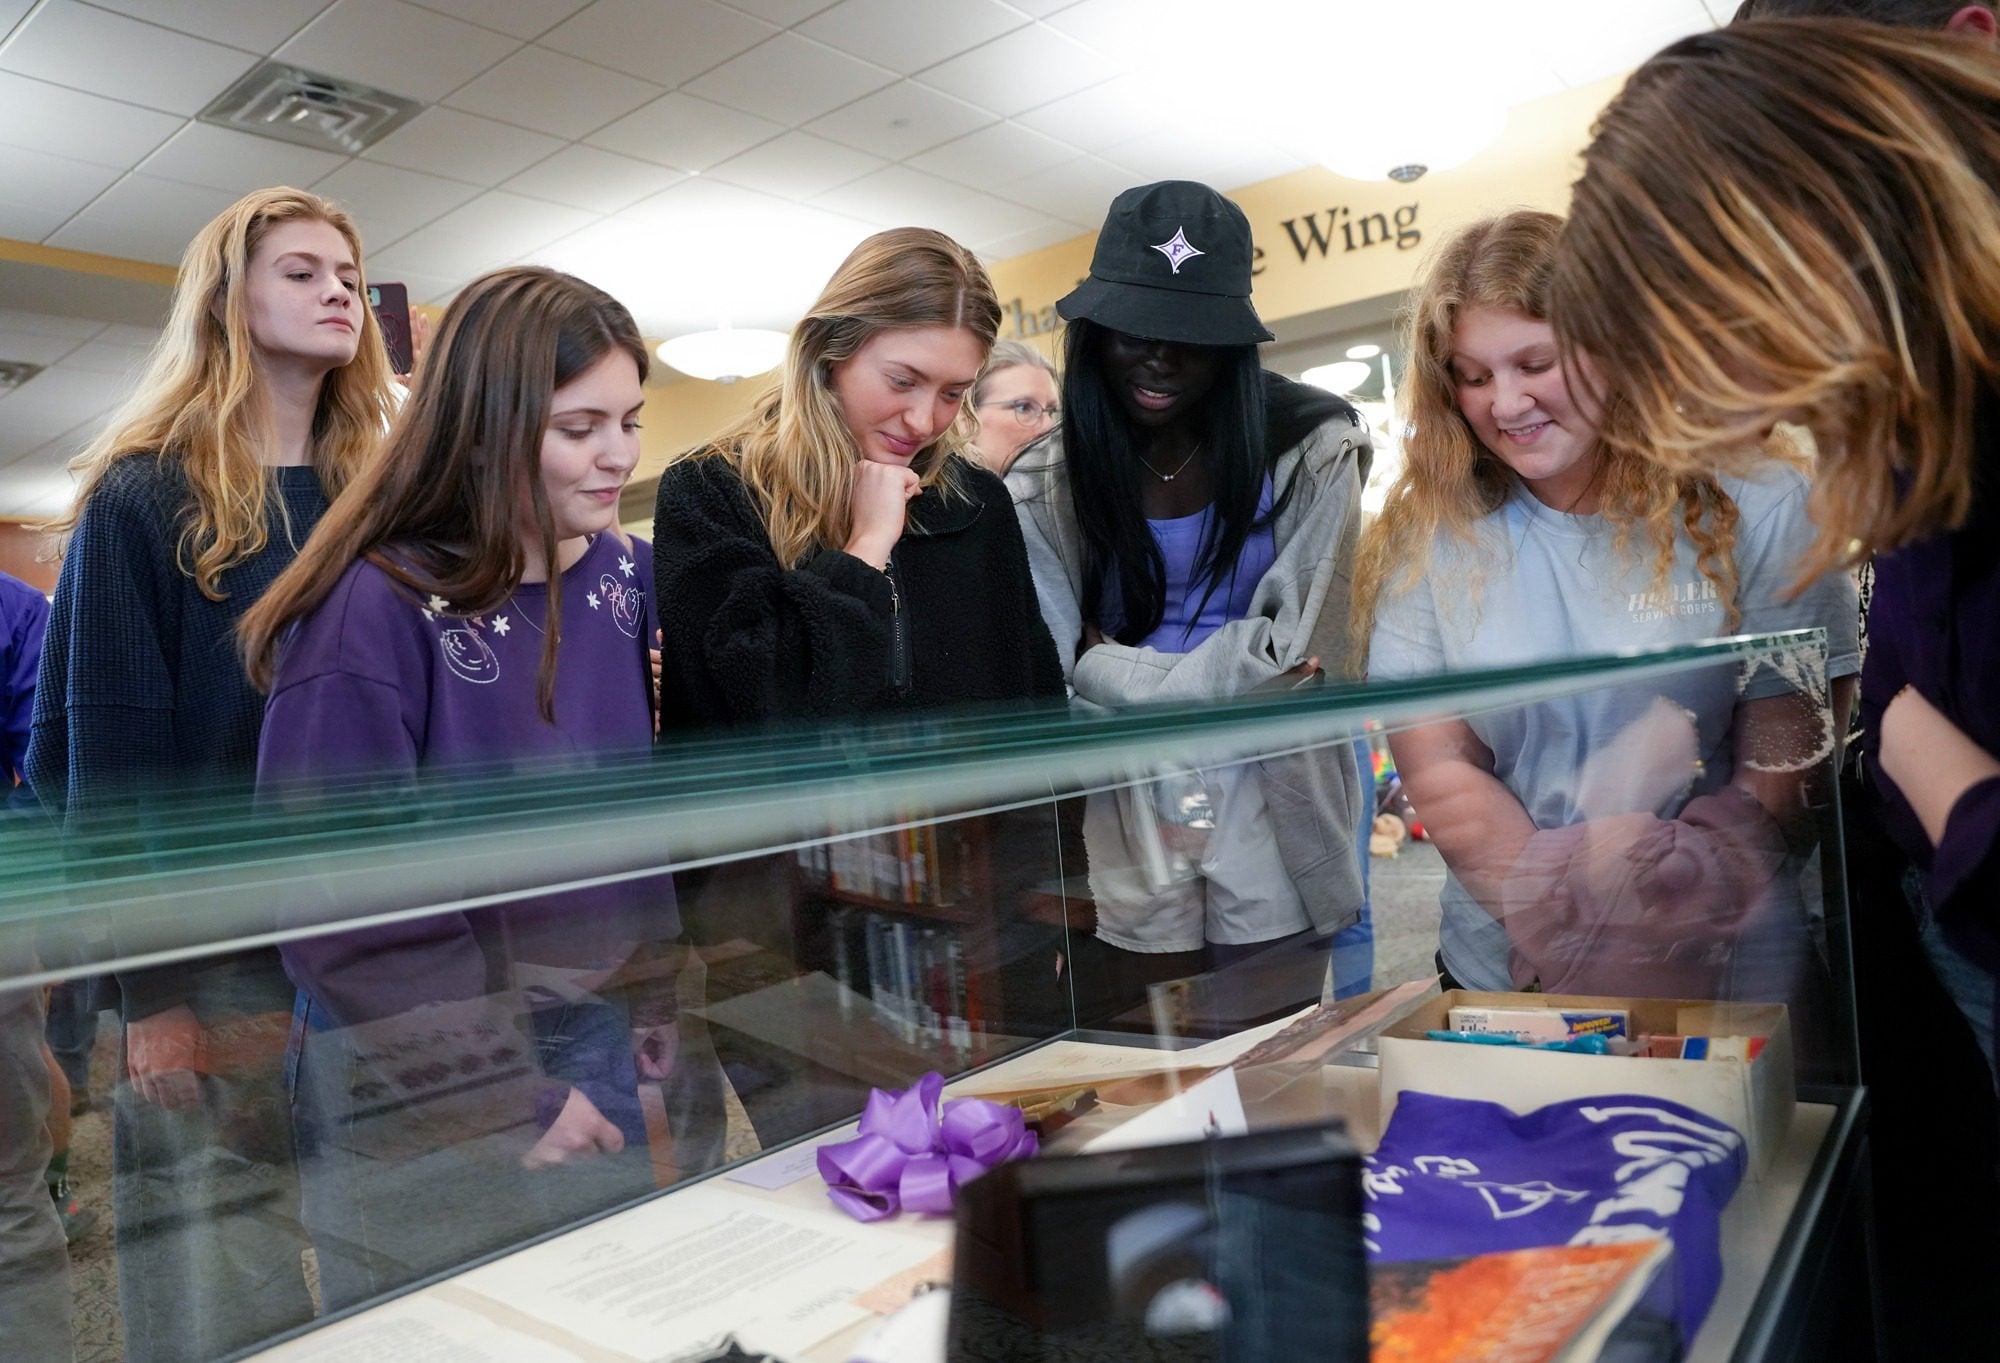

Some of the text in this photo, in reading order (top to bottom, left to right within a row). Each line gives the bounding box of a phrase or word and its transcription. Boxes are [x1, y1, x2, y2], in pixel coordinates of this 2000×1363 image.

[1280, 201, 1422, 263] Wing
[1632, 602, 1716, 624] SERVICE CORPS
